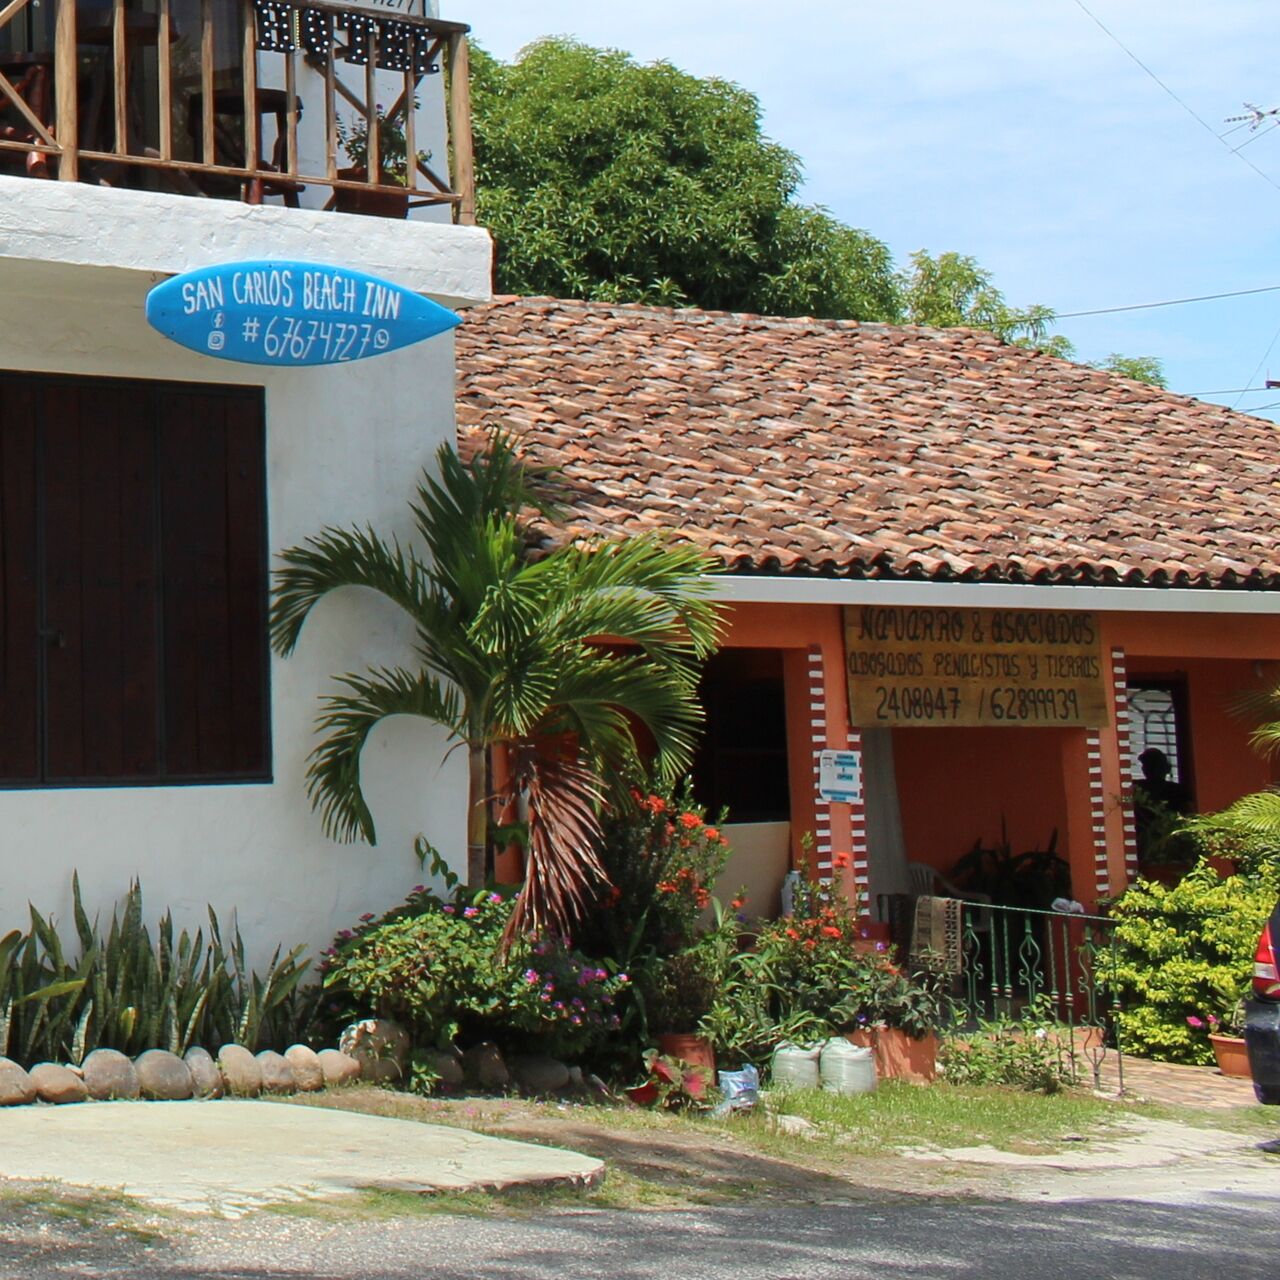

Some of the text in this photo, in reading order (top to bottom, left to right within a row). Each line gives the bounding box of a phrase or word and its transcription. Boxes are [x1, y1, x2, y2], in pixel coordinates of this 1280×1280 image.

[254, 0, 439, 72] HOTEL
[182, 270, 400, 320] SAN CARLOS BEACH INN
[875, 686, 961, 720] 2408047
[991, 687, 1079, 720] 62899939
